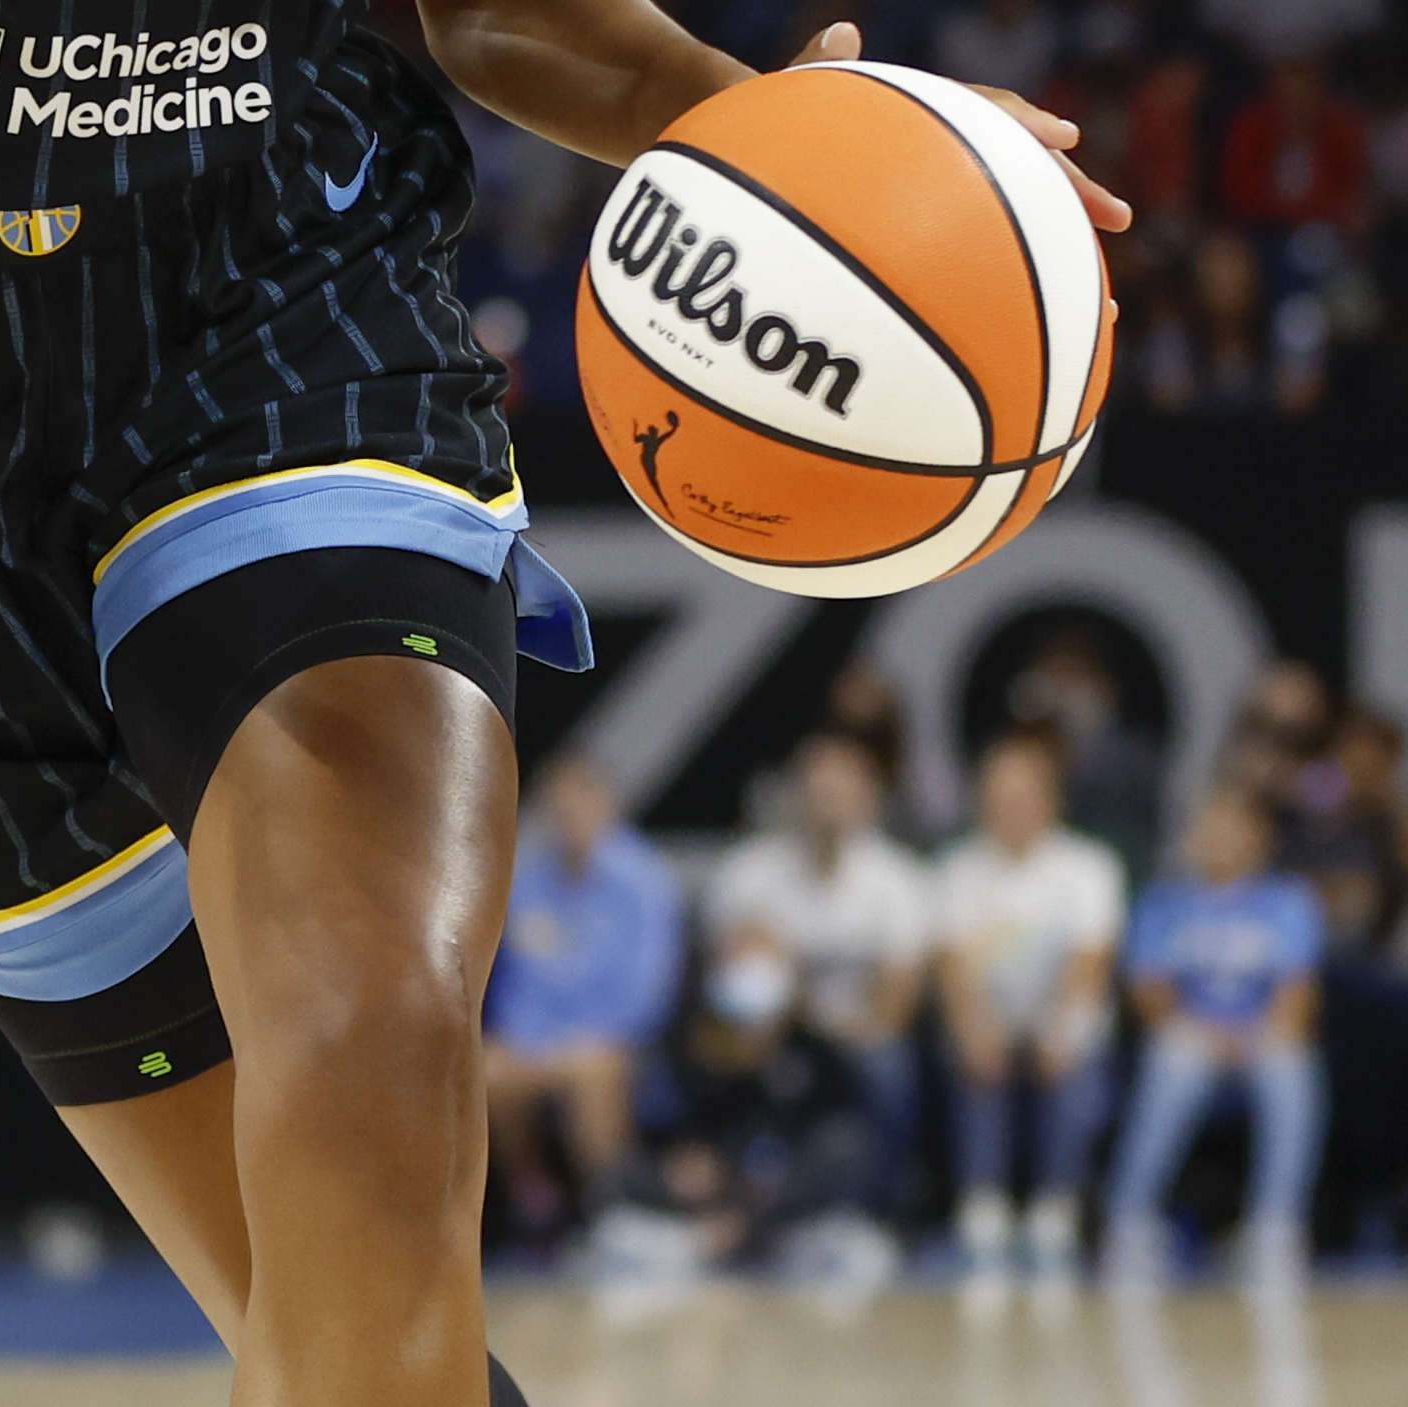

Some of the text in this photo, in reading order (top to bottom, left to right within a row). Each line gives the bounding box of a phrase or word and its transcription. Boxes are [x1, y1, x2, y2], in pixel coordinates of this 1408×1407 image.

[19, 21, 268, 79] UChicago
[6, 77, 272, 140] Medicine
[608, 177, 862, 419] Wilson
